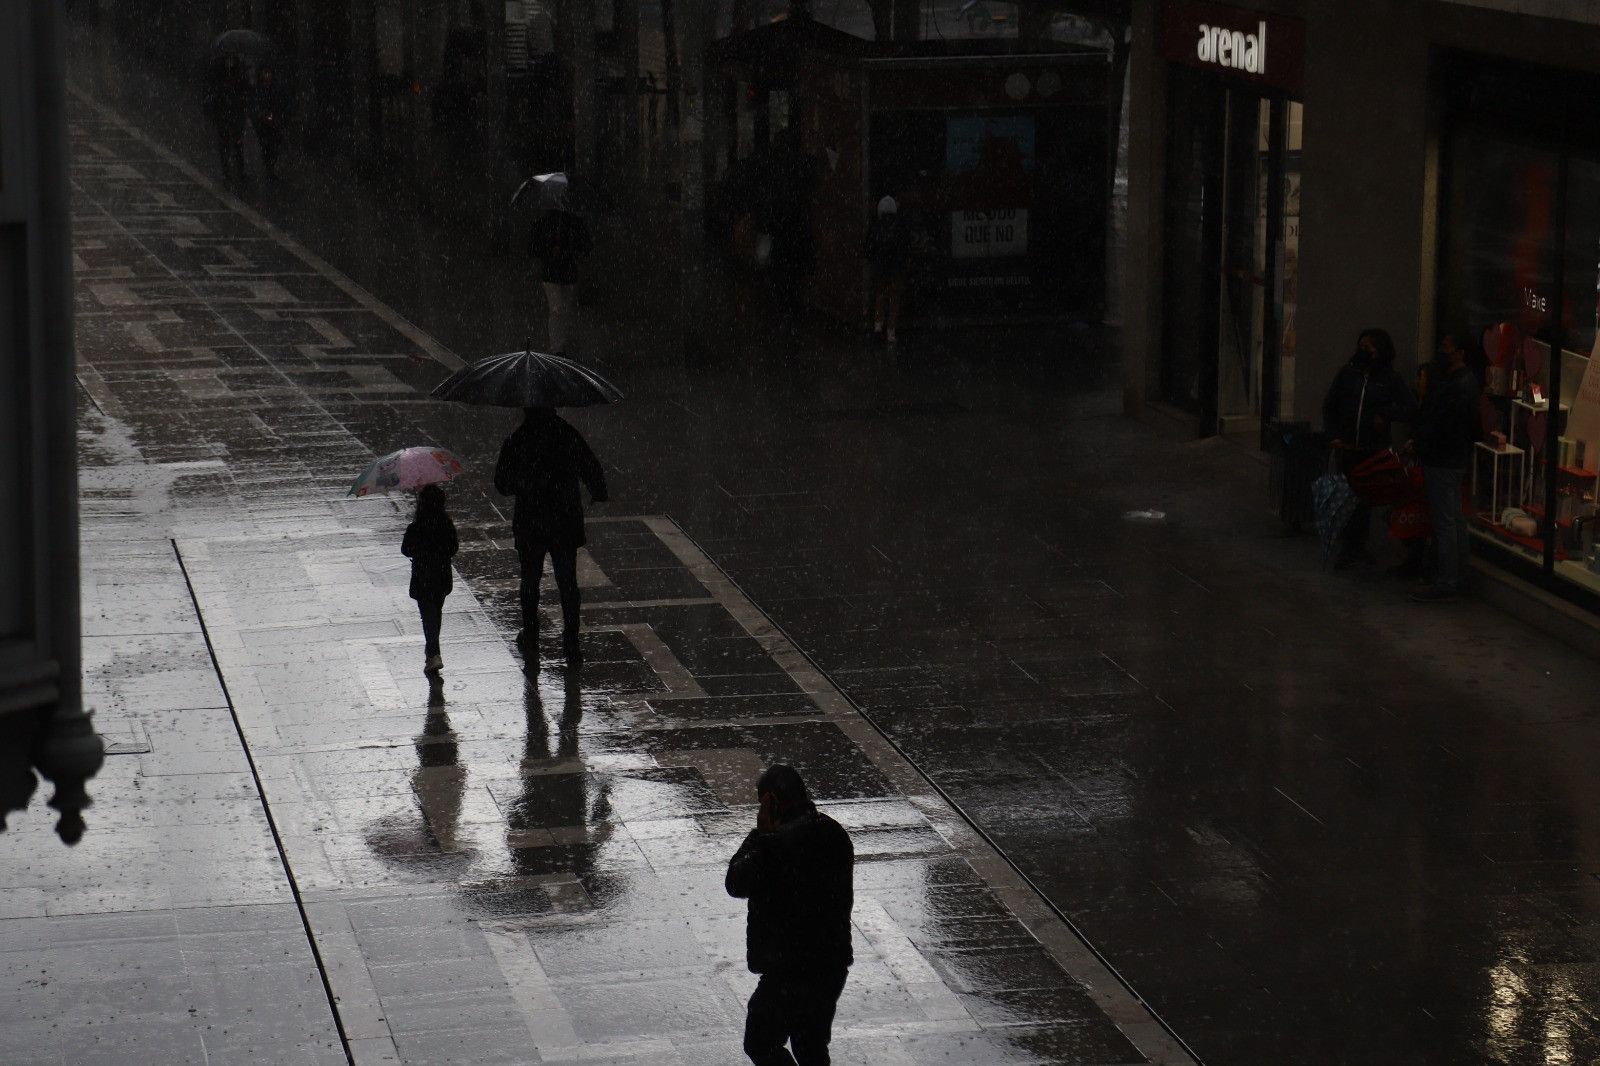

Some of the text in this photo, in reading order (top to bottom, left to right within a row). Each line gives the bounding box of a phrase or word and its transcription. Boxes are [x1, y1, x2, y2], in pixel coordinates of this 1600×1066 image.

[1197, 20, 1266, 75] arenal
[965, 224, 1014, 244] QUE NO
